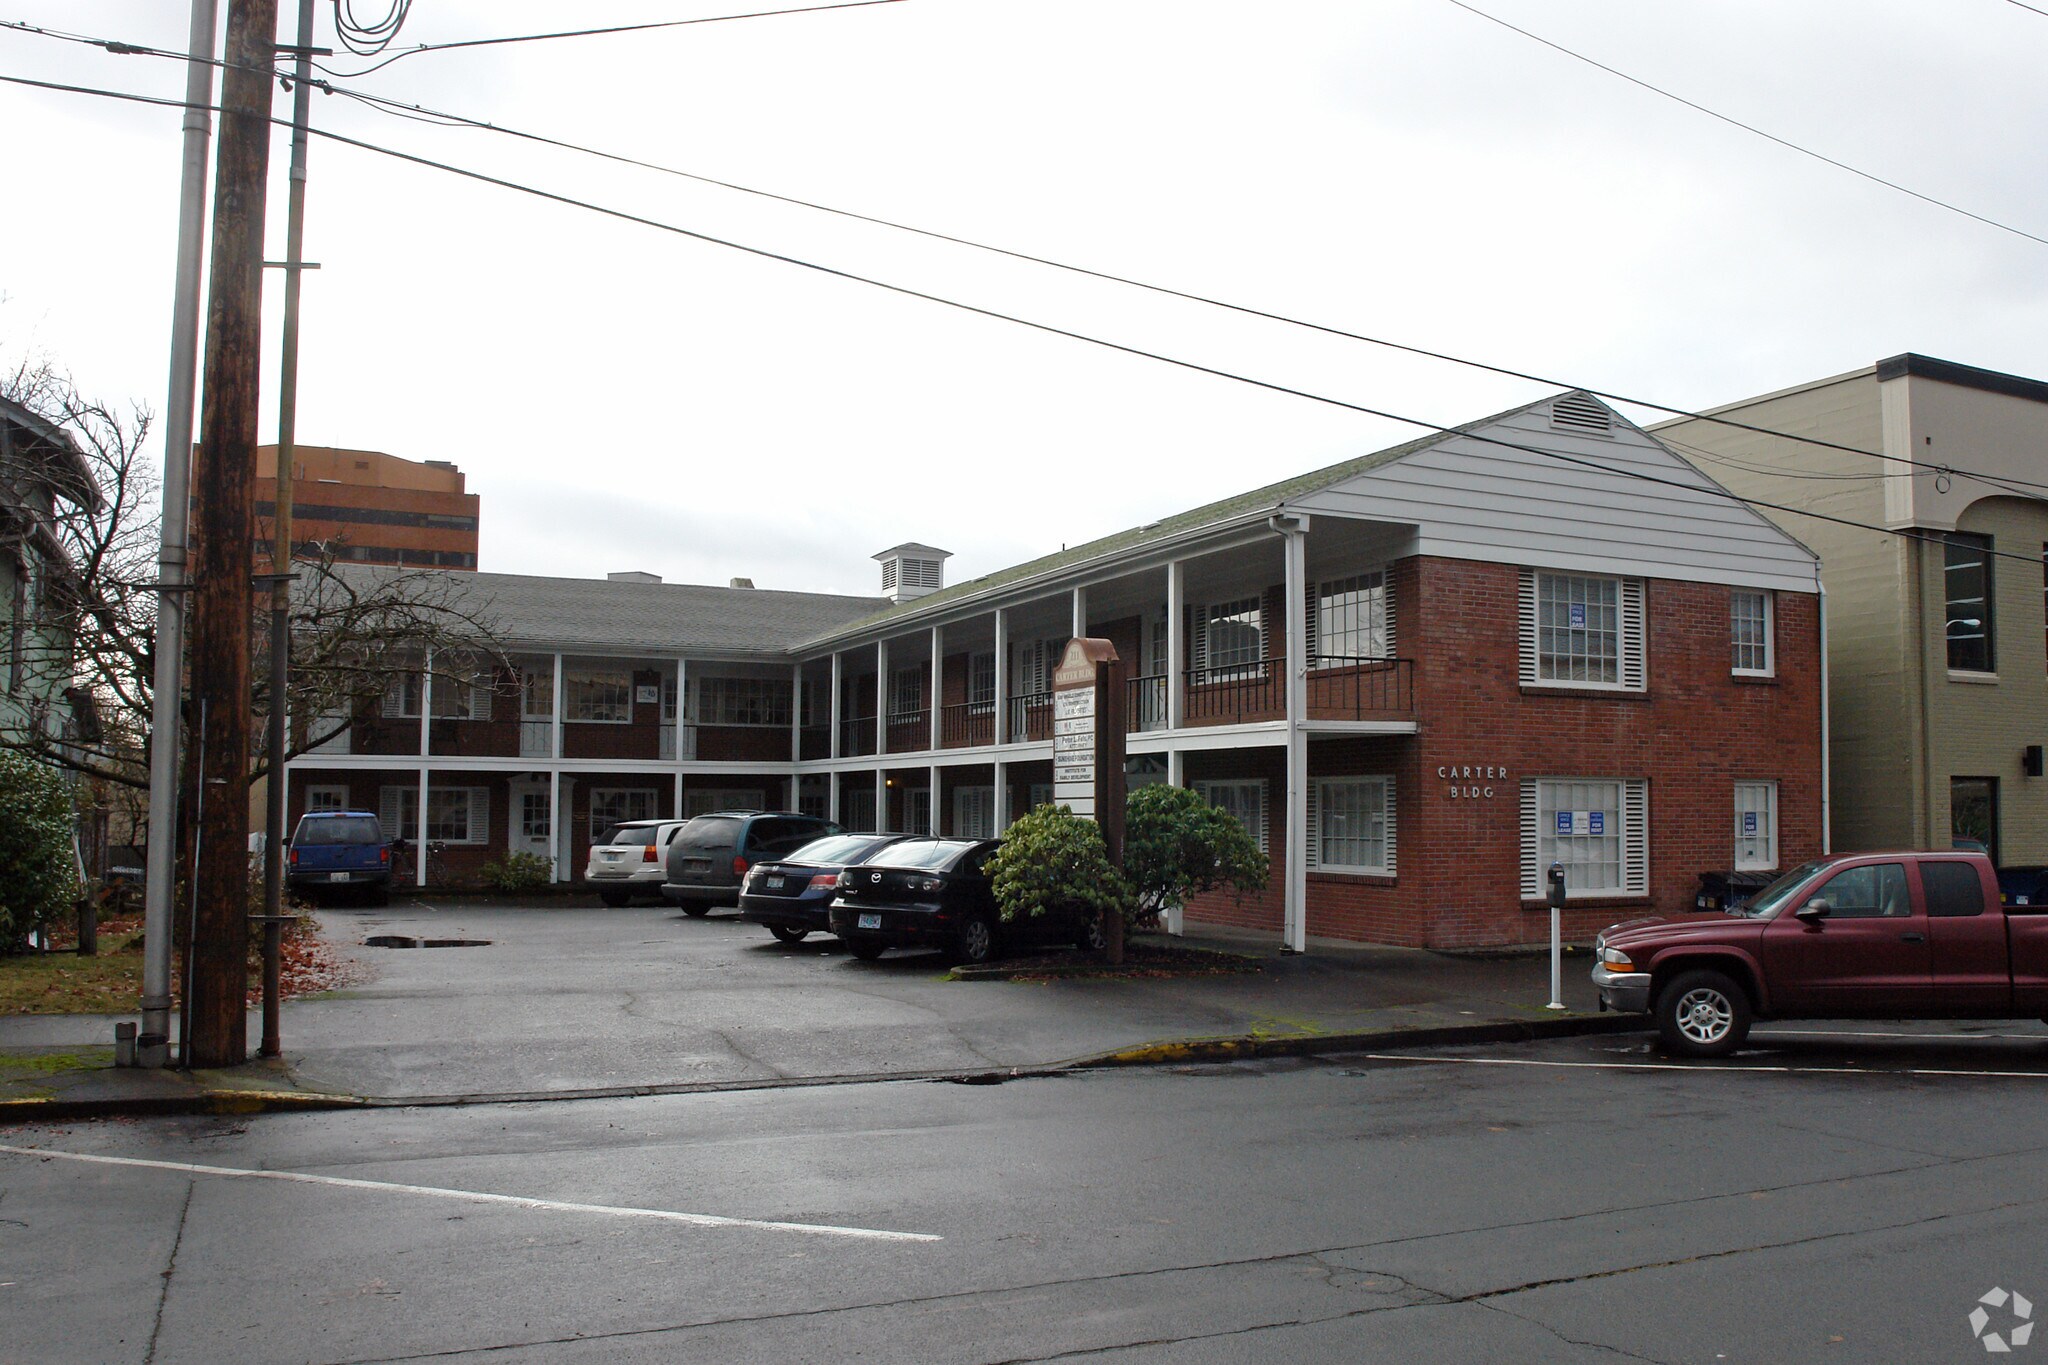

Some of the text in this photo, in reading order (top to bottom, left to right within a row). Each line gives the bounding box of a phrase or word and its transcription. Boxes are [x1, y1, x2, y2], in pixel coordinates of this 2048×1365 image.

[1056, 671, 1077, 681] CARTER
[1438, 766, 1507, 779] CARTER
[1450, 786, 1494, 798] BLDG
